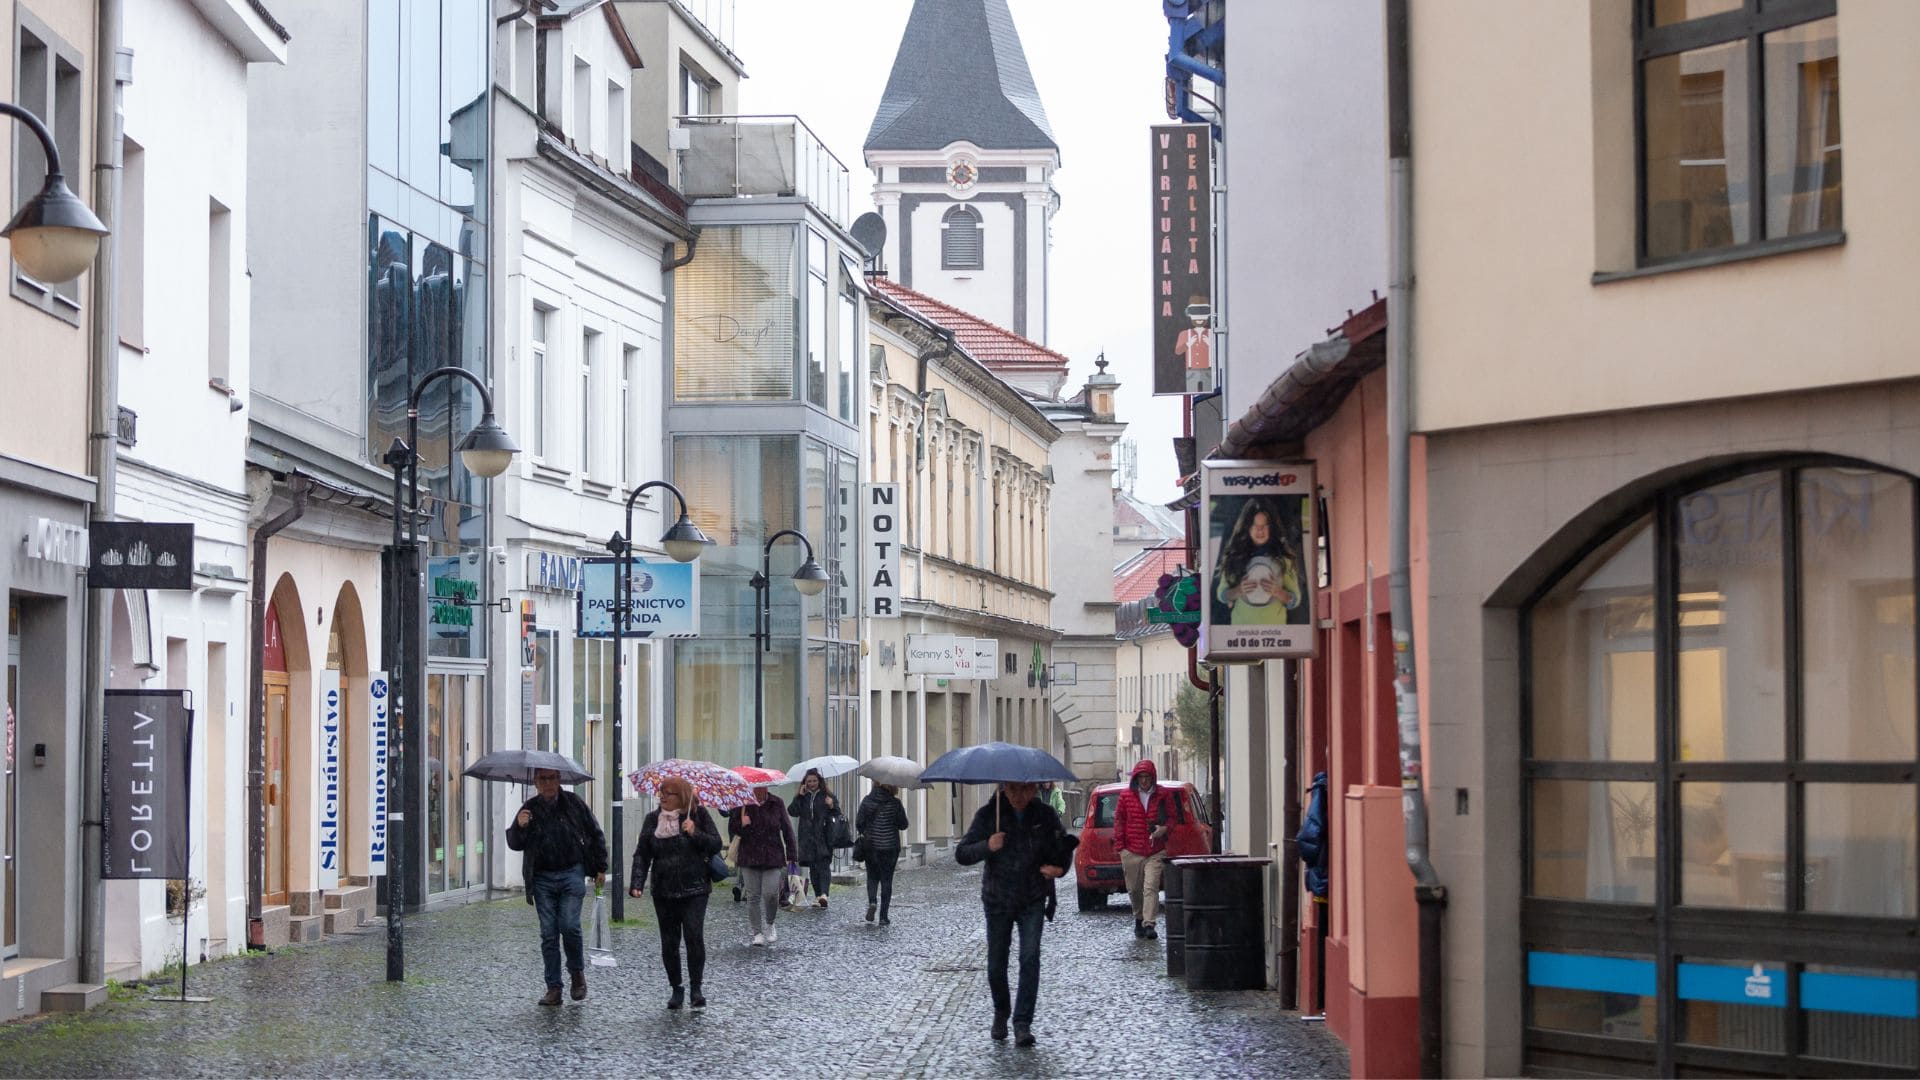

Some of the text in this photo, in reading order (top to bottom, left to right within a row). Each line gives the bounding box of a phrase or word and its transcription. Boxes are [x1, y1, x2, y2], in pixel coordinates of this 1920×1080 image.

[1159, 133, 1172, 317] VIRTUÁLNA
[1186, 133, 1199, 274] REALITA
[541, 551, 586, 591] RANDA
[588, 599, 686, 609] PAPERNICTVO
[872, 487, 893, 615] NOTÁR
[910, 649, 942, 662] Kenny
[944, 649, 953, 660] S.
[1227, 638, 1239, 647] od
[1248, 638, 1260, 647] do
[1261, 637, 1276, 648] 172
[1277, 639, 1292, 648] cm
[320, 690, 339, 870] Sklenárstvo
[370, 704, 388, 863] Rámovanie
